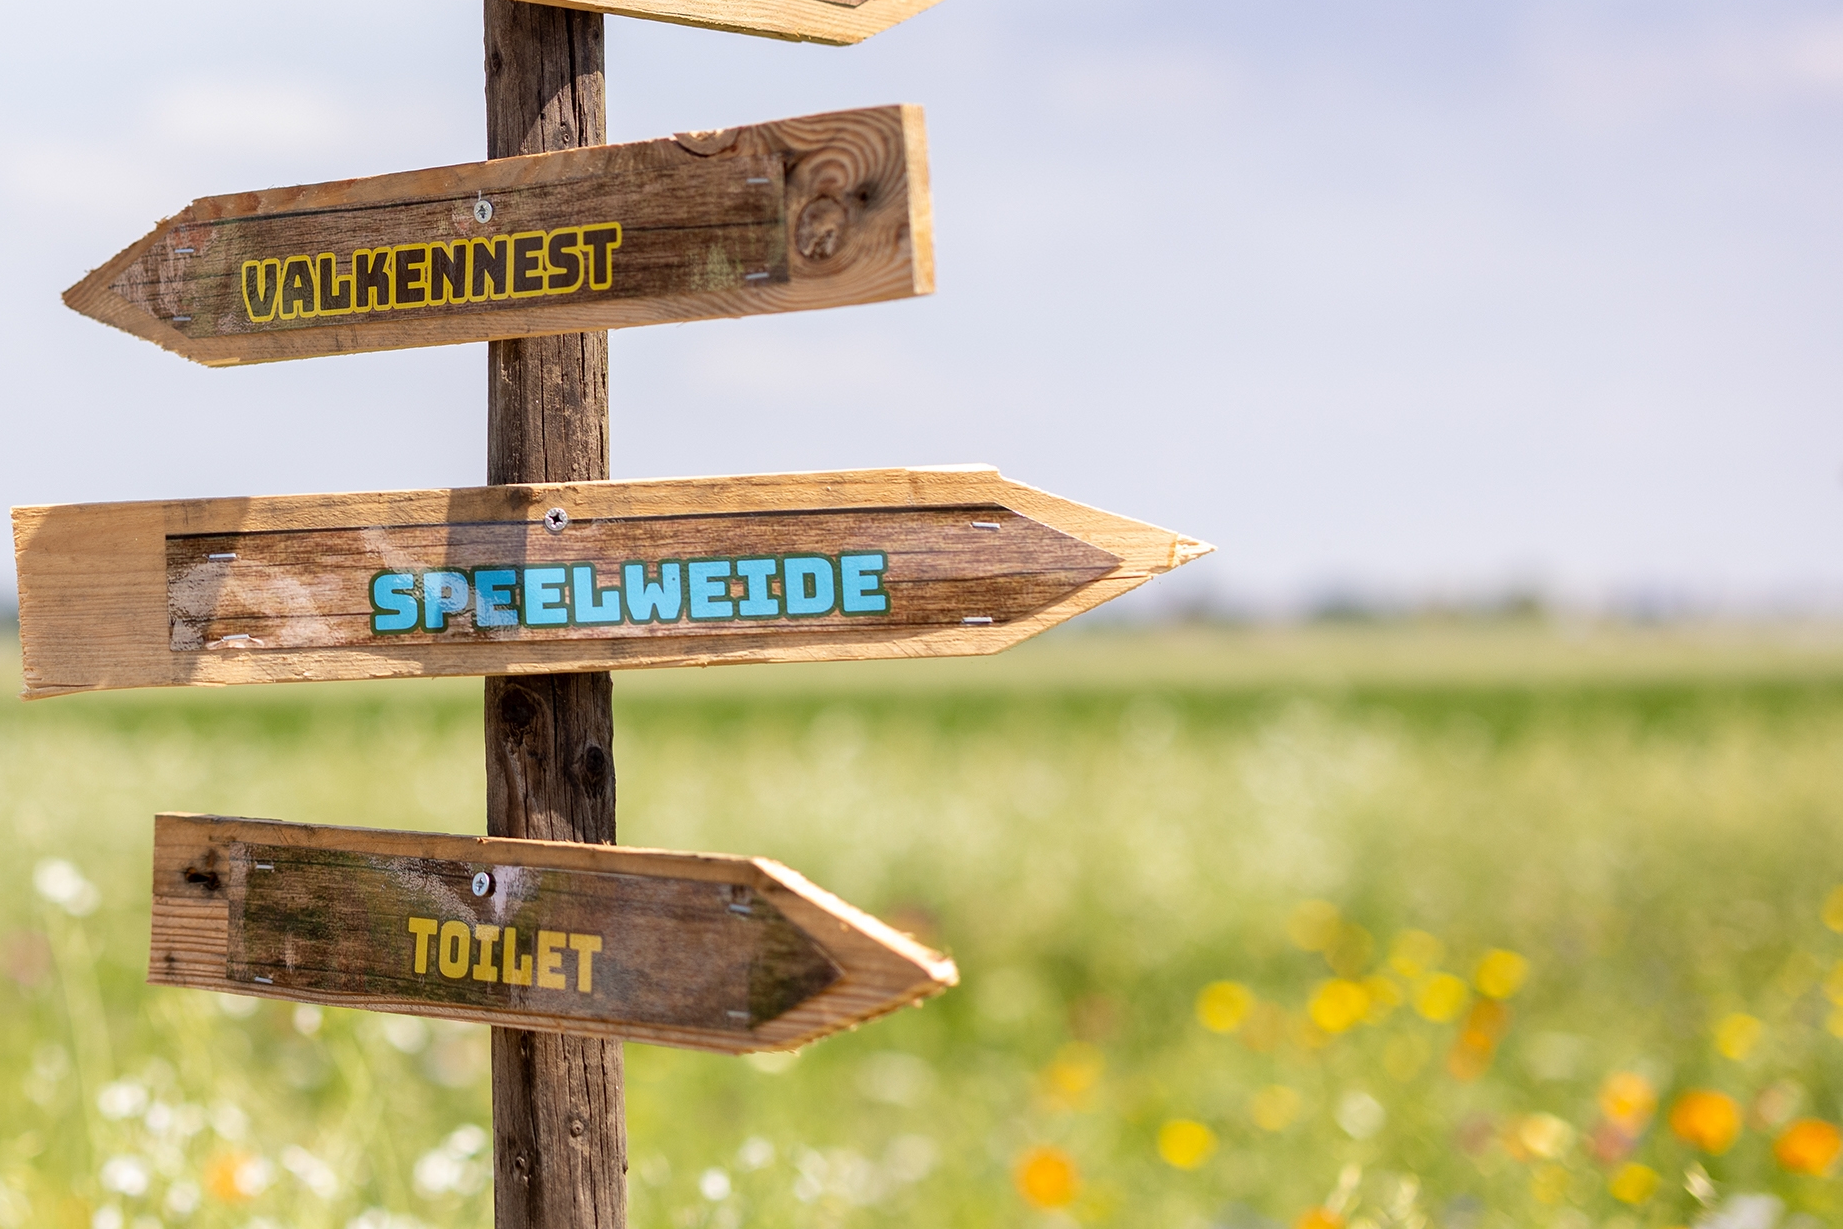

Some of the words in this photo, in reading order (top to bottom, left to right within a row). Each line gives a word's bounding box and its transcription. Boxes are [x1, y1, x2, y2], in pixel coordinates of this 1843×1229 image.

[241, 222, 622, 323] VALKENNEST
[370, 550, 890, 635] SPEELWEIDE
[408, 916, 603, 993] TOILET
